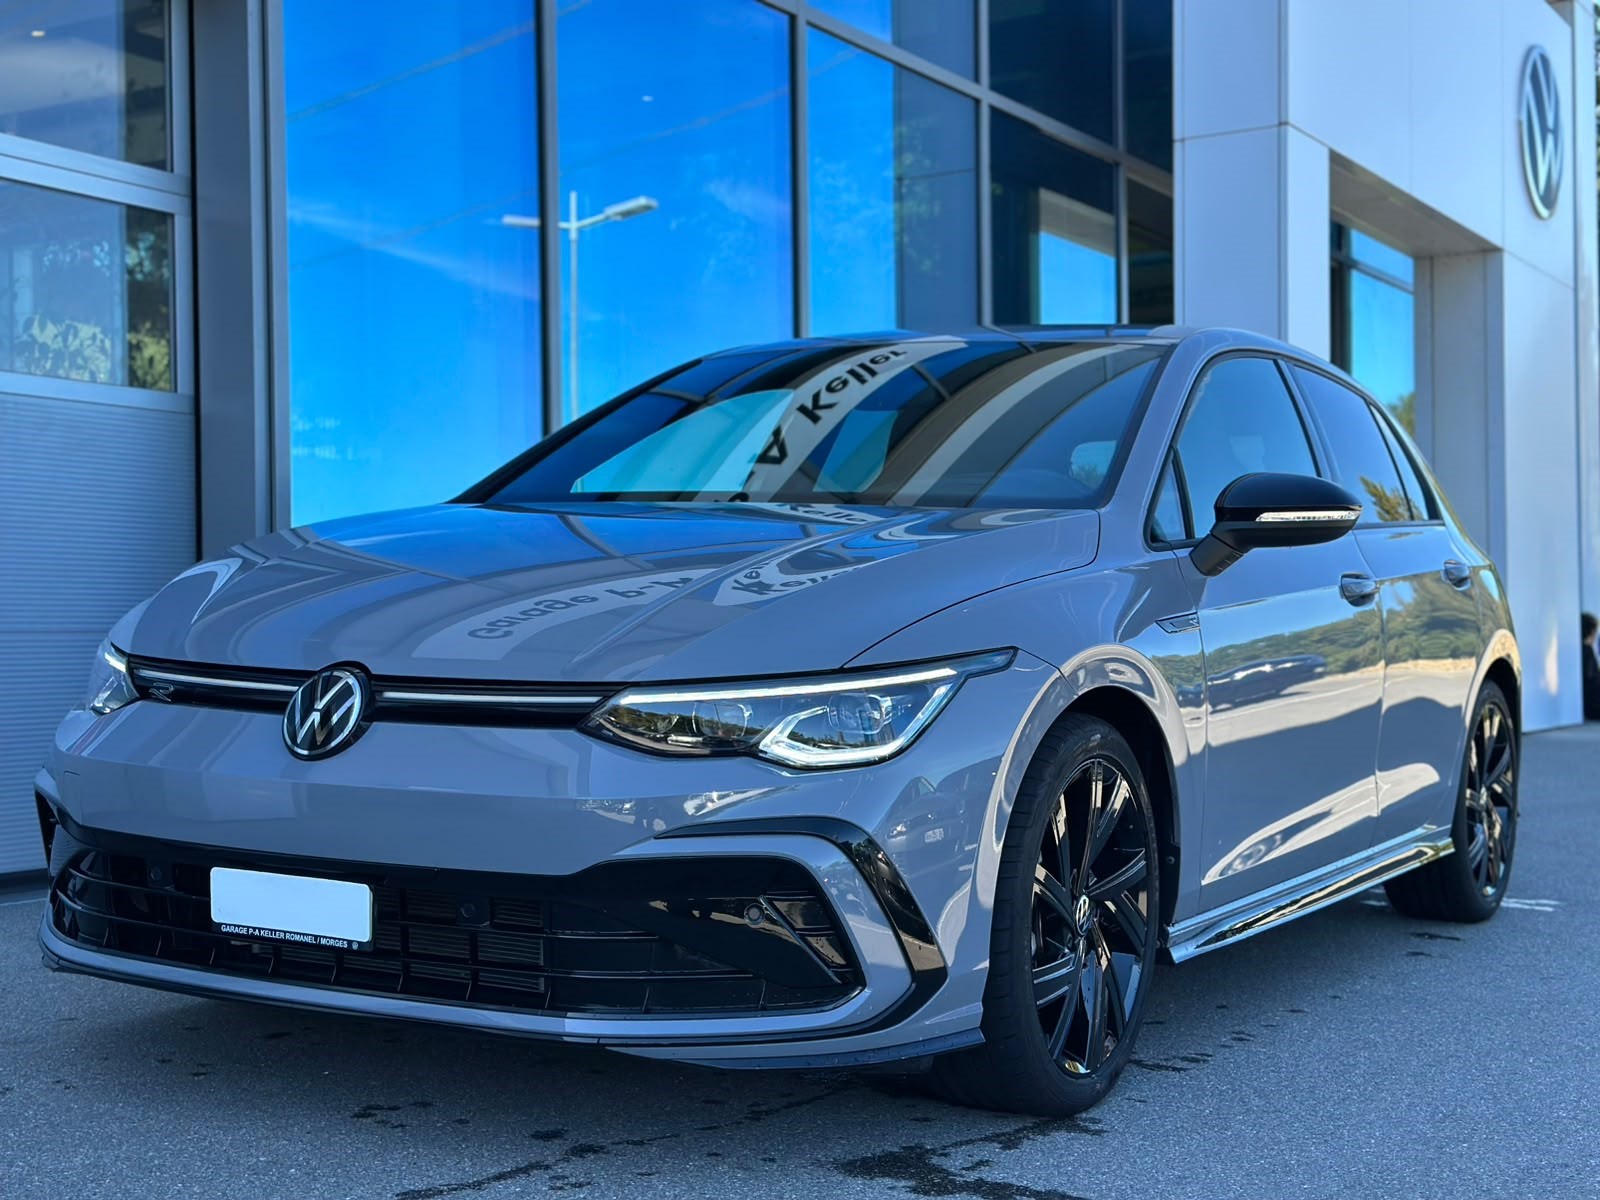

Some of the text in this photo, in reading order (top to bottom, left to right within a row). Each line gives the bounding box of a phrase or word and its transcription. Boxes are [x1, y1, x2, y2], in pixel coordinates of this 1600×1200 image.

[220, 924, 248, 935] GARAGE
[248, 927, 260, 936] P-A
[260, 929, 285, 940] KELLER
[285, 932, 316, 944] ROMANEL
[320, 937, 348, 948] MORGES
